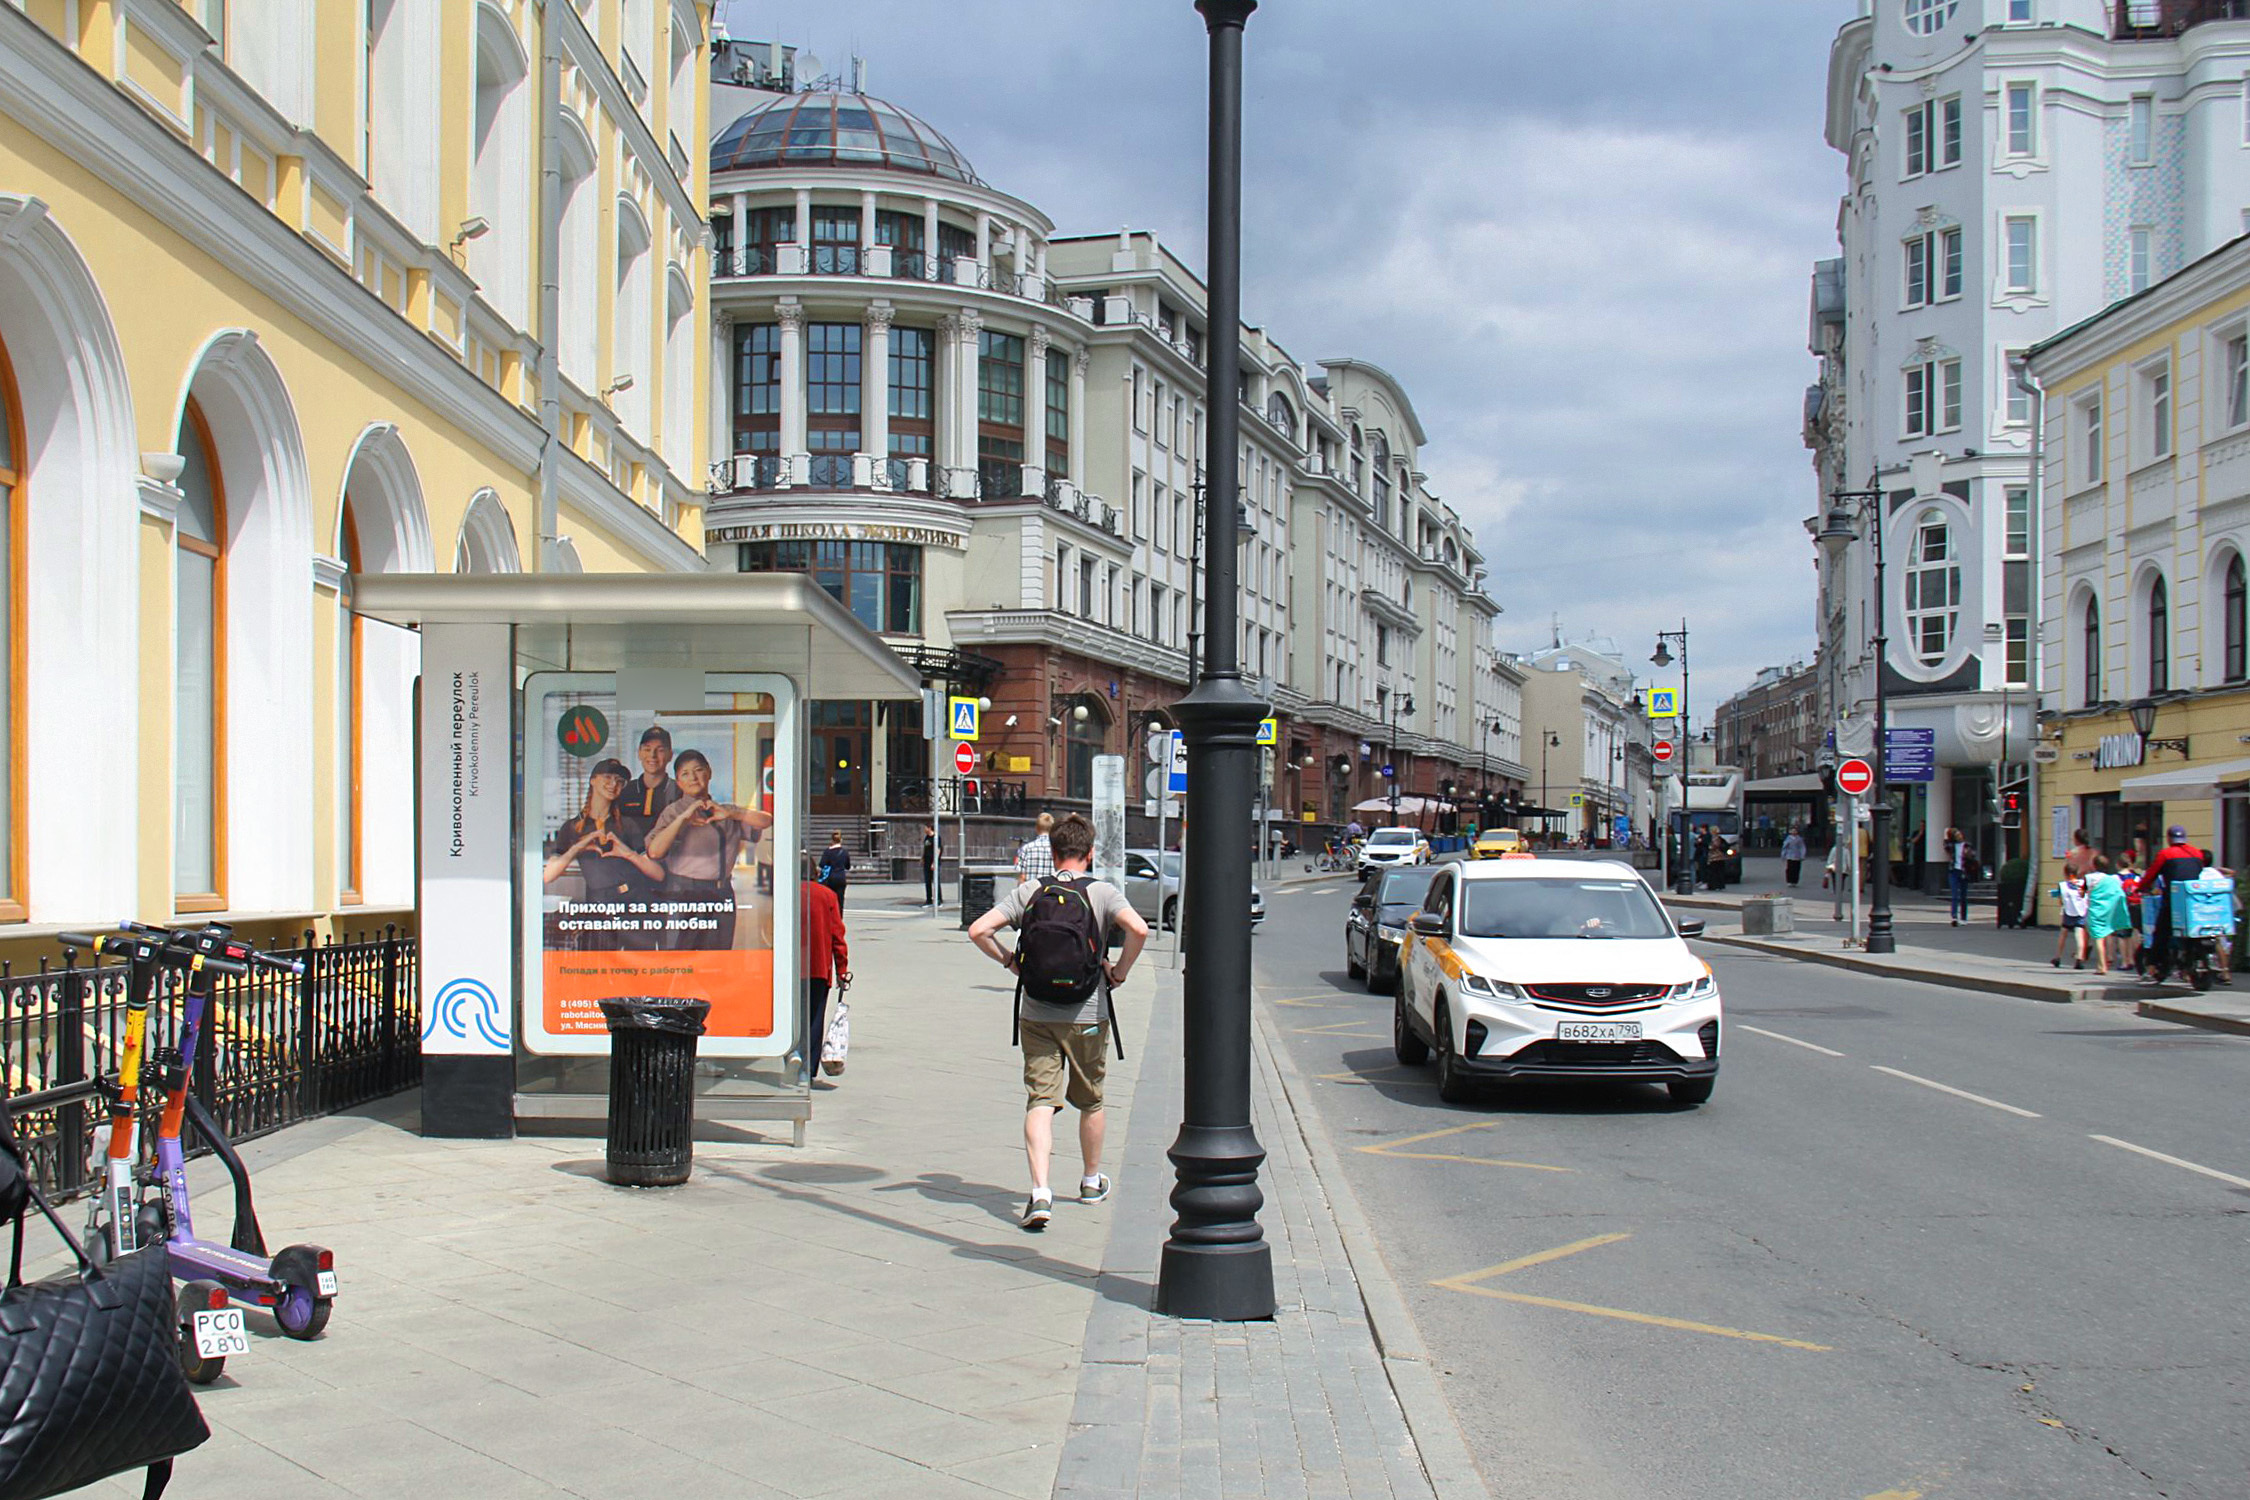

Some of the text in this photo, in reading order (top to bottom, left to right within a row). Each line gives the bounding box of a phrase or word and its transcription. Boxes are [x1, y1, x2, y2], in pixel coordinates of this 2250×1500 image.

[781, 523, 850, 538] ШКОЛА
[857, 524, 961, 548] ЭКОНОМИКИ
[469, 671, 481, 797] Krivokolenniy Pereulok
[2099, 732, 2142, 769] TORINO
[450, 671, 466, 857] Кривоколенный переулок
[559, 901, 626, 916] Приходи
[628, 902, 647, 914] за
[650, 899, 734, 915] зарплатой
[558, 916, 718, 931] оставайся по любви
[559, 966, 598, 975] Попади
[601, 967, 607, 975] в
[610, 967, 639, 976] точку
[649, 966, 693, 976] работой
[560, 1000, 567, 1009] 8
[568, 1000, 592, 1010] (495)
[560, 1022, 574, 1031] ул.
[1564, 1025, 1639, 1038] В682ХА 790
[201, 1337, 244, 1354] 280
